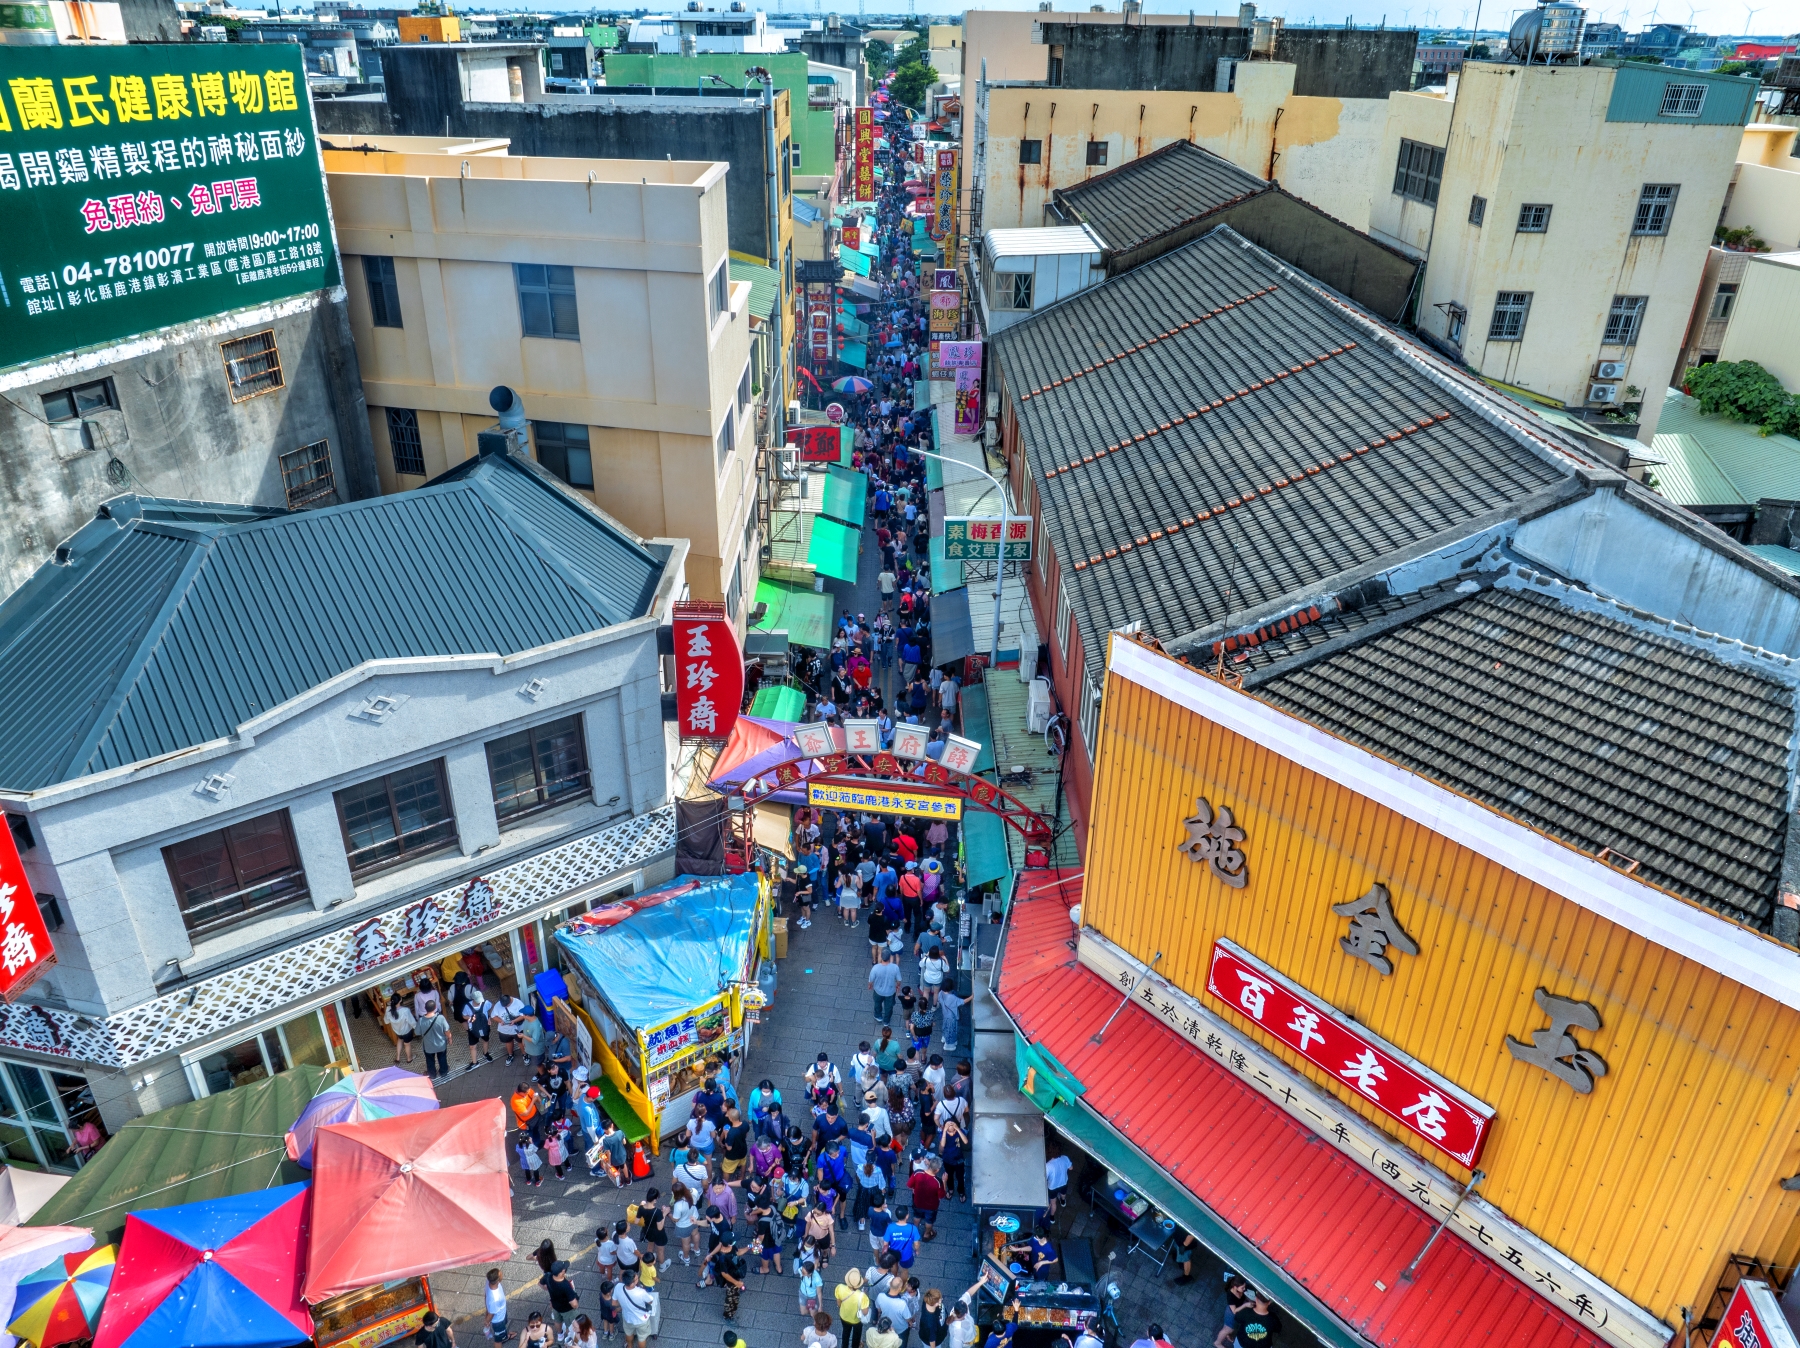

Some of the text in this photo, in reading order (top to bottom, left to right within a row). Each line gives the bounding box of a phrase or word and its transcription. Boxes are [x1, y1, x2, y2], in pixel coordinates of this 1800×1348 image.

[0, 70, 298, 132] 蘭氏健康博物館
[80, 177, 261, 233] 免預約、免門票
[63, 243, 195, 285] 04-7810077
[686, 624, 720, 733] 玉珍齋
[353, 877, 493, 962] 玉珍齋
[647, 1016, 695, 1049] 魷魚王
[1235, 968, 1452, 1142] 百年老店
